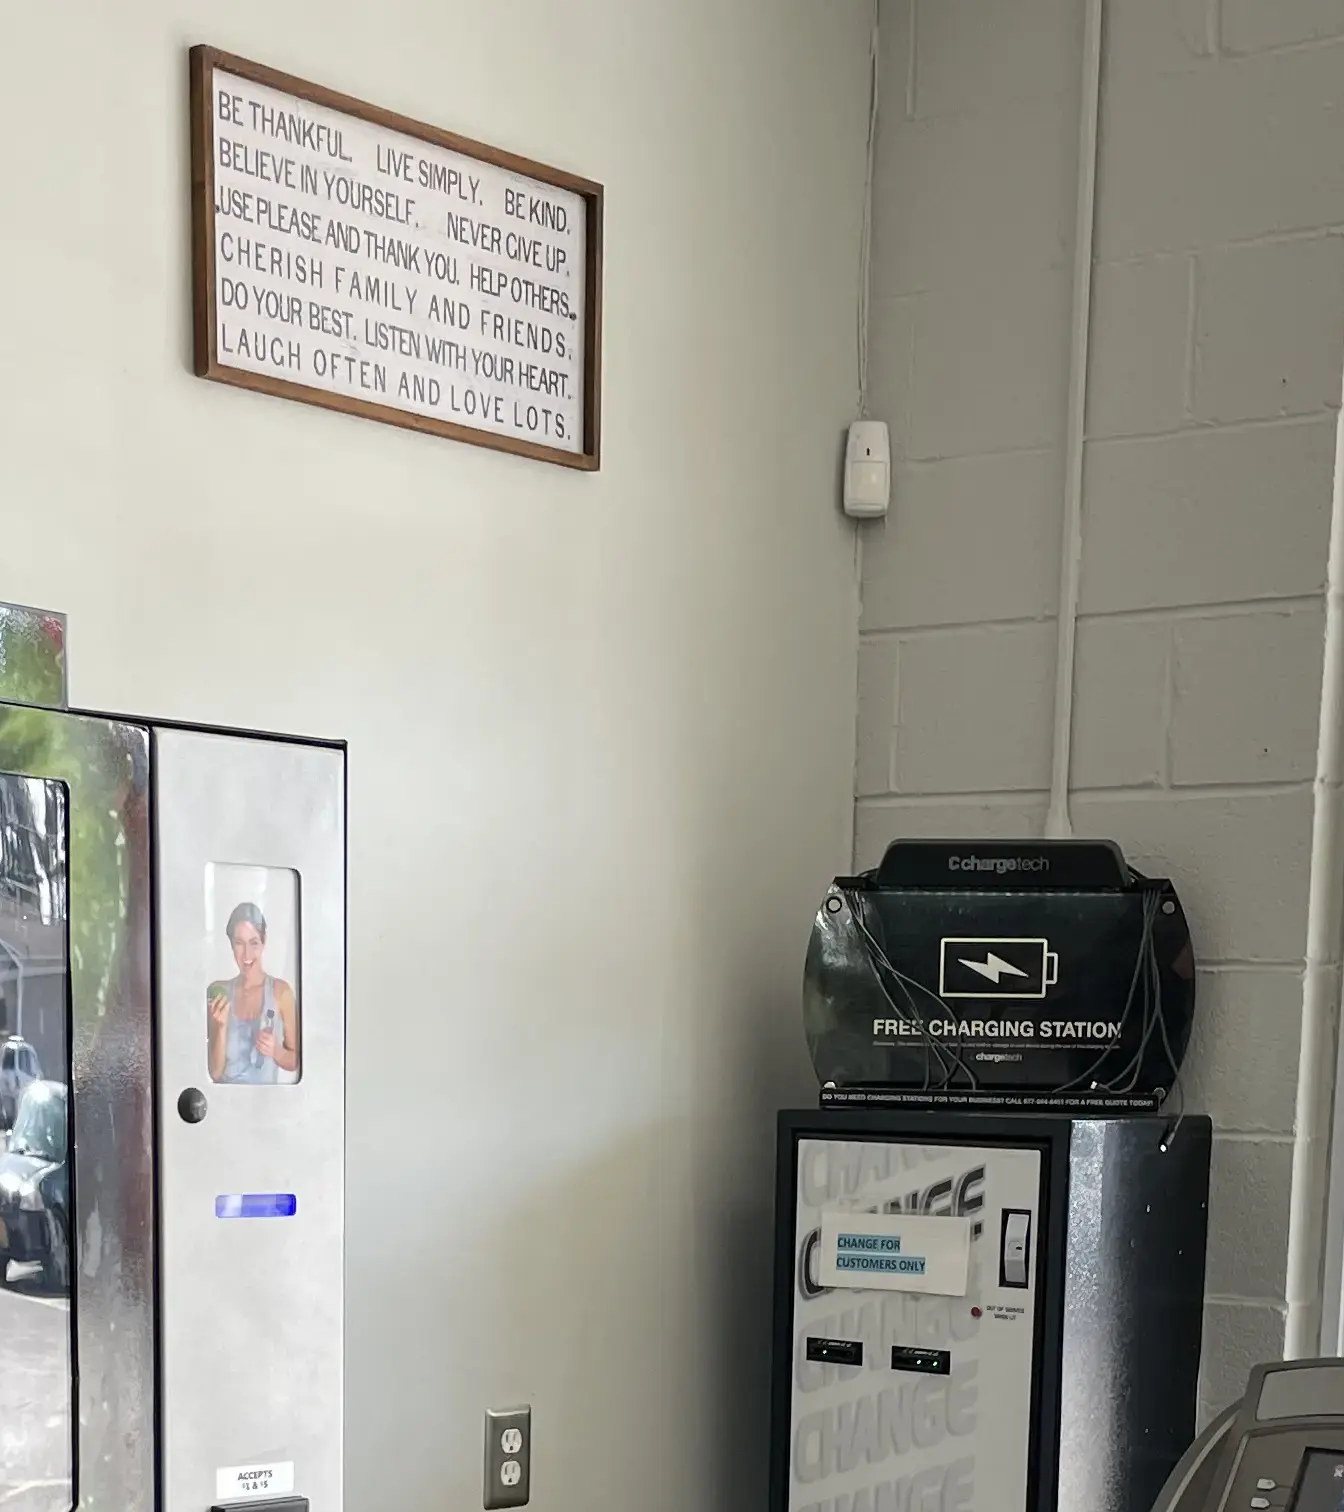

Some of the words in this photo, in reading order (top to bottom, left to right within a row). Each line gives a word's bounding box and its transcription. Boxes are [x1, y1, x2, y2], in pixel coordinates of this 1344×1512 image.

[218, 91, 243, 125] BE
[249, 101, 352, 162] THANKFUL.
[377, 144, 414, 182] LIVE
[418, 160, 483, 206] SIMPLY.
[505, 188, 526, 218] BE
[530, 200, 570, 235] KIND.
[219, 139, 295, 189] BELIEVE
[301, 164, 317, 196] IN
[323, 171, 419, 228] YOURSELF.
[447, 212, 501, 255] NEVER
[506, 234, 543, 268] GIVE
[546, 246, 569, 276] UP.
[220, 187, 254, 222] USE
[257, 202, 322, 243] PLEASE
[325, 220, 360, 253] AND
[364, 230, 420, 273] THANK
[425, 251, 460, 286] YOU.
[470, 263, 508, 298] HELP
[511, 278, 574, 320] OTHERS.
[220, 233, 323, 289] CHERISH
[335, 267, 417, 314] FAMILY
[428, 294, 470, 330] AND
[481, 313, 572, 360] FRIENDS.
[221, 277, 248, 310] DO
[252, 285, 302, 325] YOUR
[308, 300, 357, 341] BEST.
[365, 319, 420, 359] LISTEN
[426, 338, 467, 371] WITH
[471, 353, 514, 385] YOUR
[518, 367, 572, 400] HEART.
[222, 324, 301, 371] LAUGH
[313, 349, 386, 392] OFTEN
[398, 373, 440, 406] AND
[451, 385, 504, 423] LOVE
[513, 402, 571, 440] LOTS.
[929, 1020, 1034, 1037] CHARGING
[1040, 1022, 1122, 1038] STATION
[836, 1256, 897, 1270] CUSTOMERS
[899, 1259, 925, 1272] ONLY
[838, 1237, 879, 1250] CHANGE
[880, 1239, 900, 1251] FOR
[238, 1470, 273, 1481] ACCEPTS
